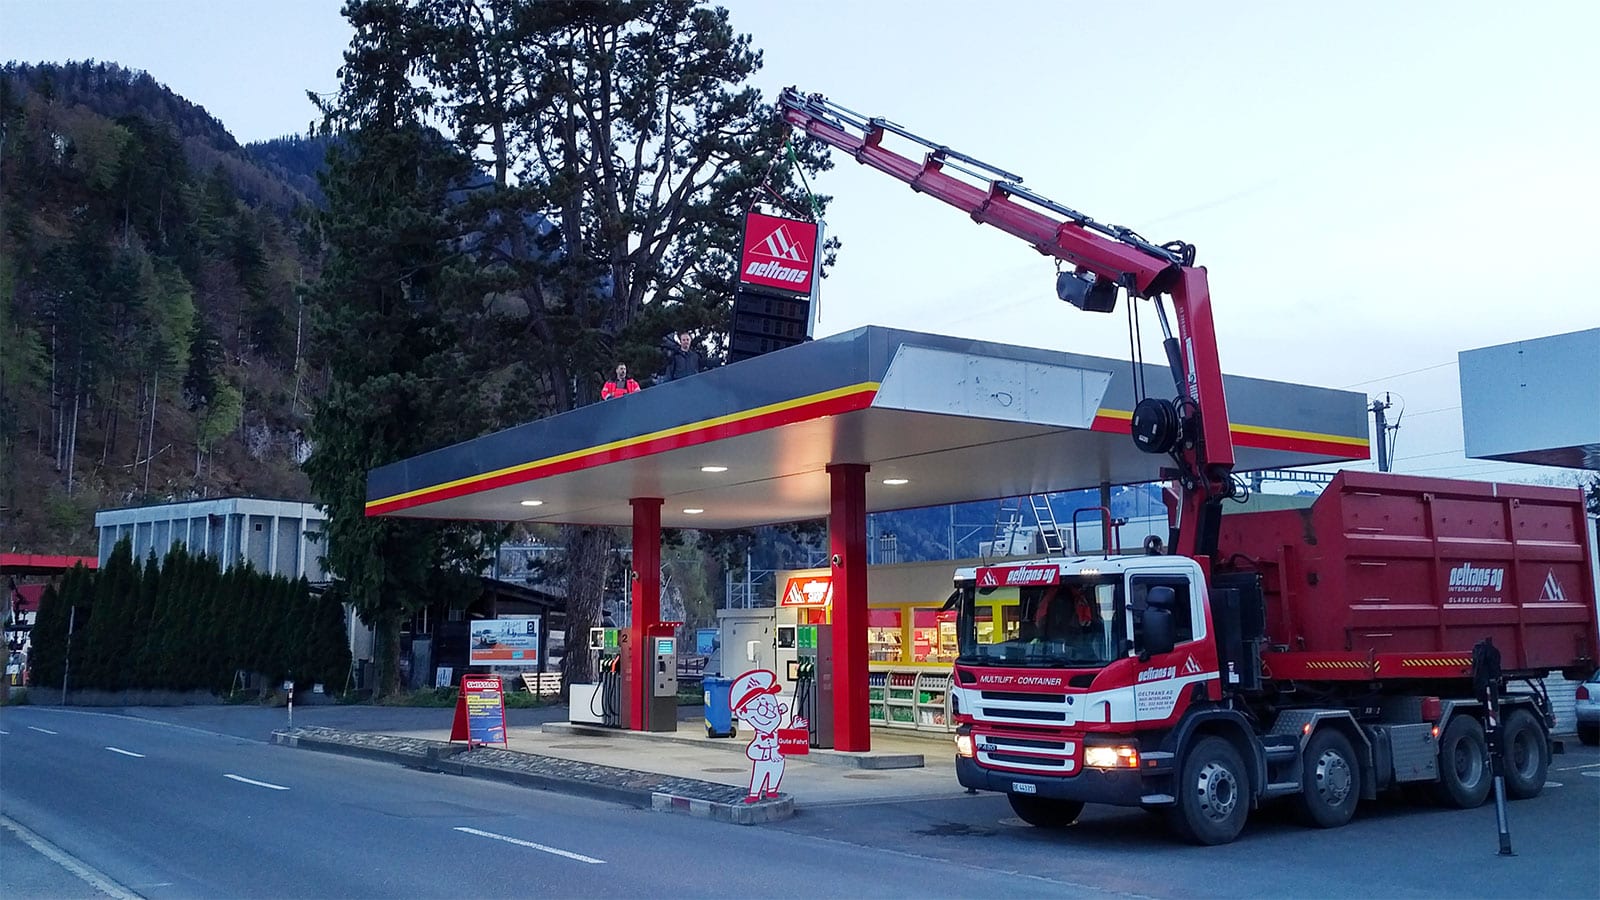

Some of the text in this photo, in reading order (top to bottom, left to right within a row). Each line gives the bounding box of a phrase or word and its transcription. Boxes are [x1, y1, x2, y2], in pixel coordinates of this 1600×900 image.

[745, 260, 808, 284] oeltrans
[1006, 566, 1056, 584] oeltrans ag
[1449, 562, 1504, 591] oeltrans ag
[622, 634, 628, 643] 2
[980, 675, 1014, 684] MULTILIFT
[1017, 676, 1062, 686] CONTAINER
[1138, 665, 1176, 682] oeltrans ag
